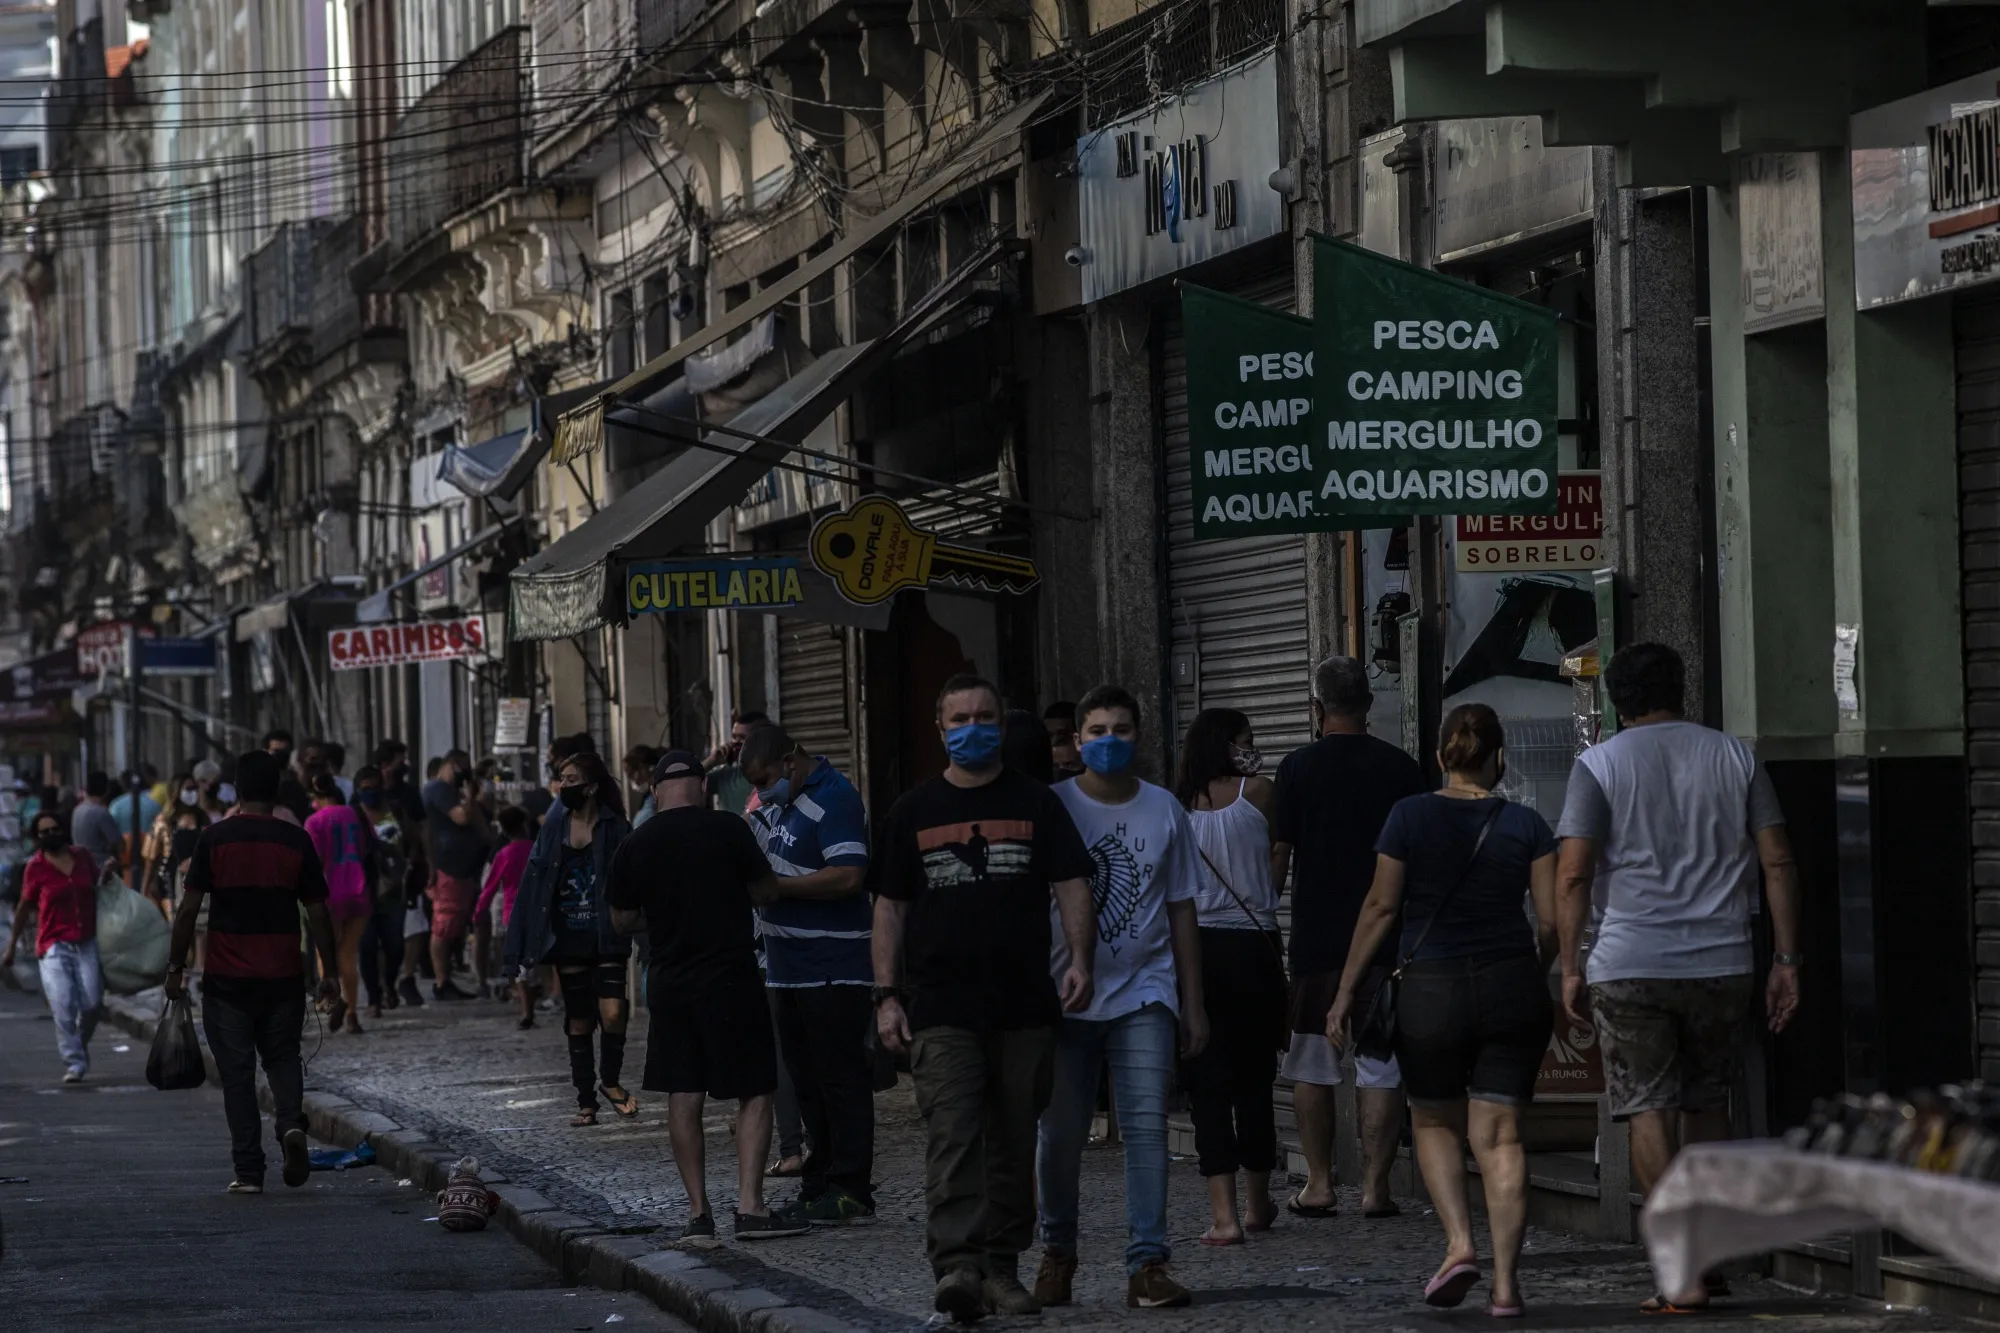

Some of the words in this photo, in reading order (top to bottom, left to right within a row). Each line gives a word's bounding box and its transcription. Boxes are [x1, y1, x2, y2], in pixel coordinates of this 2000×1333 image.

[1374, 320, 1499, 350] PESCA
[1347, 369, 1523, 400] CAMPING
[1215, 398, 1313, 430] CAMP
[1328, 418, 1543, 450] MERGULHO
[1320, 468, 1549, 501] AQUARISMO
[1202, 490, 1313, 523] AQUAR
[858, 513, 884, 590] DOVALE
[1467, 544, 1604, 565] SOBRELO
[629, 567, 803, 610] CUTELARIA
[331, 618, 482, 661] CARIMBOS
[1552, 1069, 1588, 1079] RUMOS
